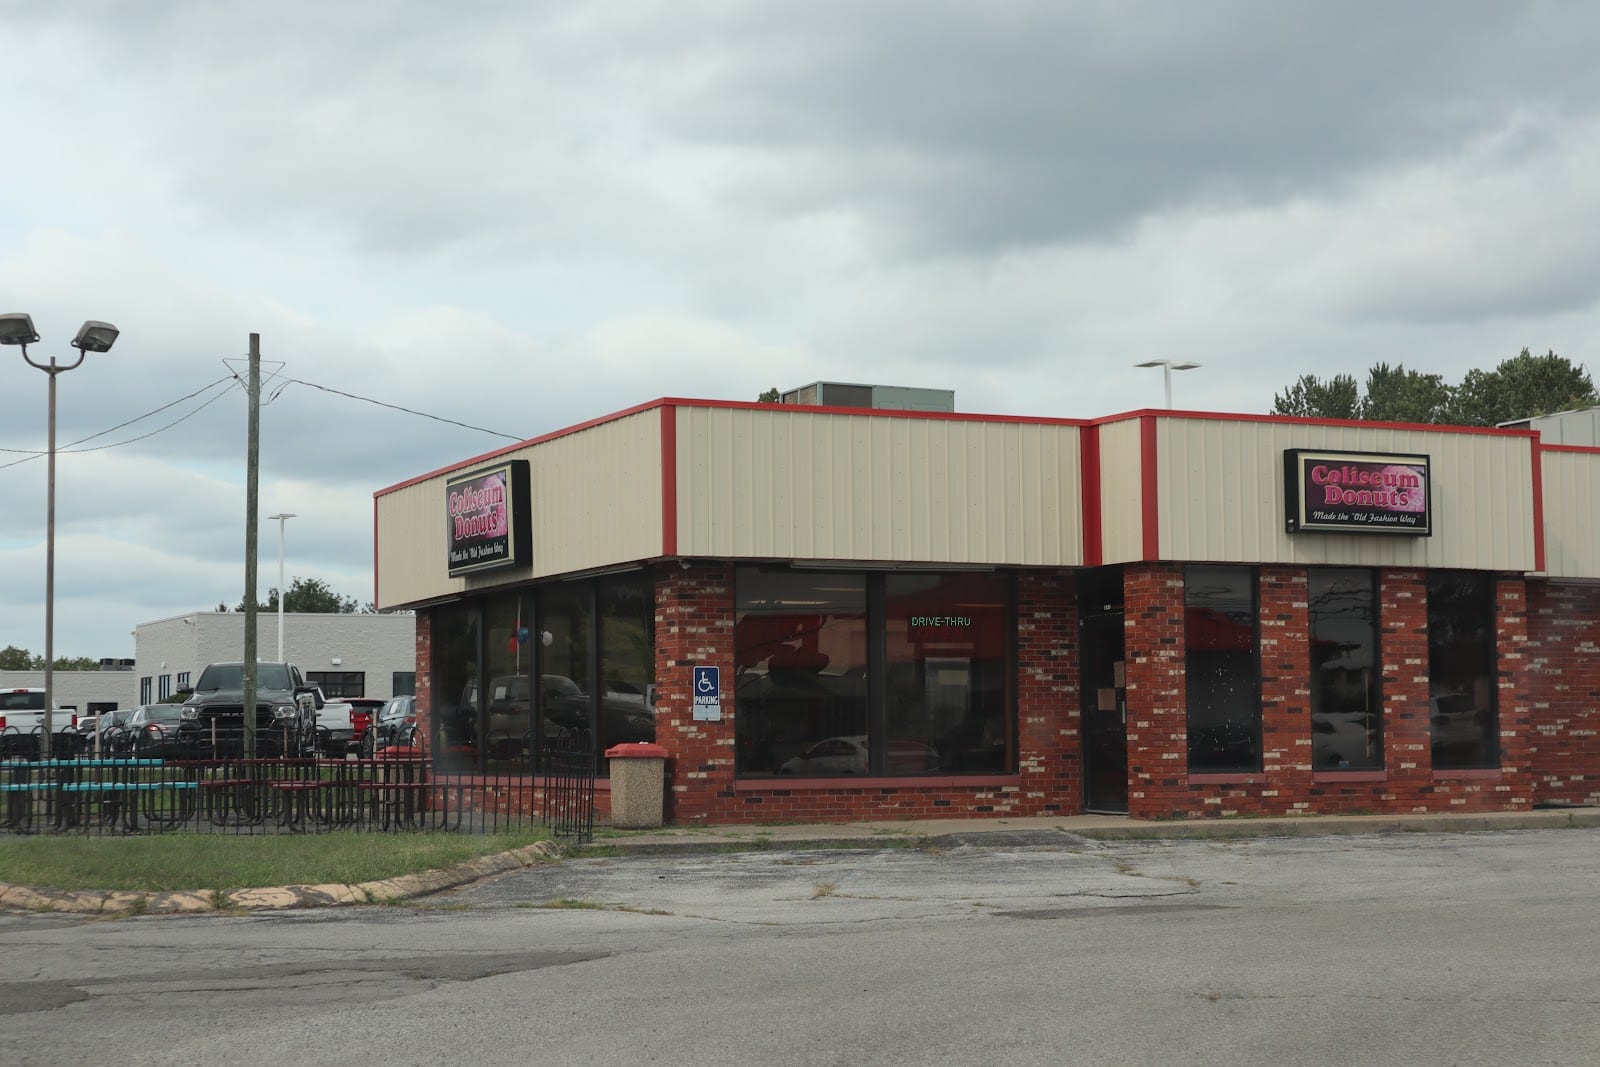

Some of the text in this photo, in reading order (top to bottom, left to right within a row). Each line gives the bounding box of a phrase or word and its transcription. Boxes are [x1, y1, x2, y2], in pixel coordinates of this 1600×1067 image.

[1311, 465, 1419, 487] Coliseum
[449, 486, 503, 517] Coliseum
[1324, 485, 1409, 506] Donuts
[455, 511, 498, 541] Donuts
[1313, 511, 1336, 520] Made
[1337, 511, 1349, 521] the
[1368, 513, 1398, 523] Fashion
[911, 616, 971, 627] DRIVE-THRU
[695, 696, 718, 705] PARKING
